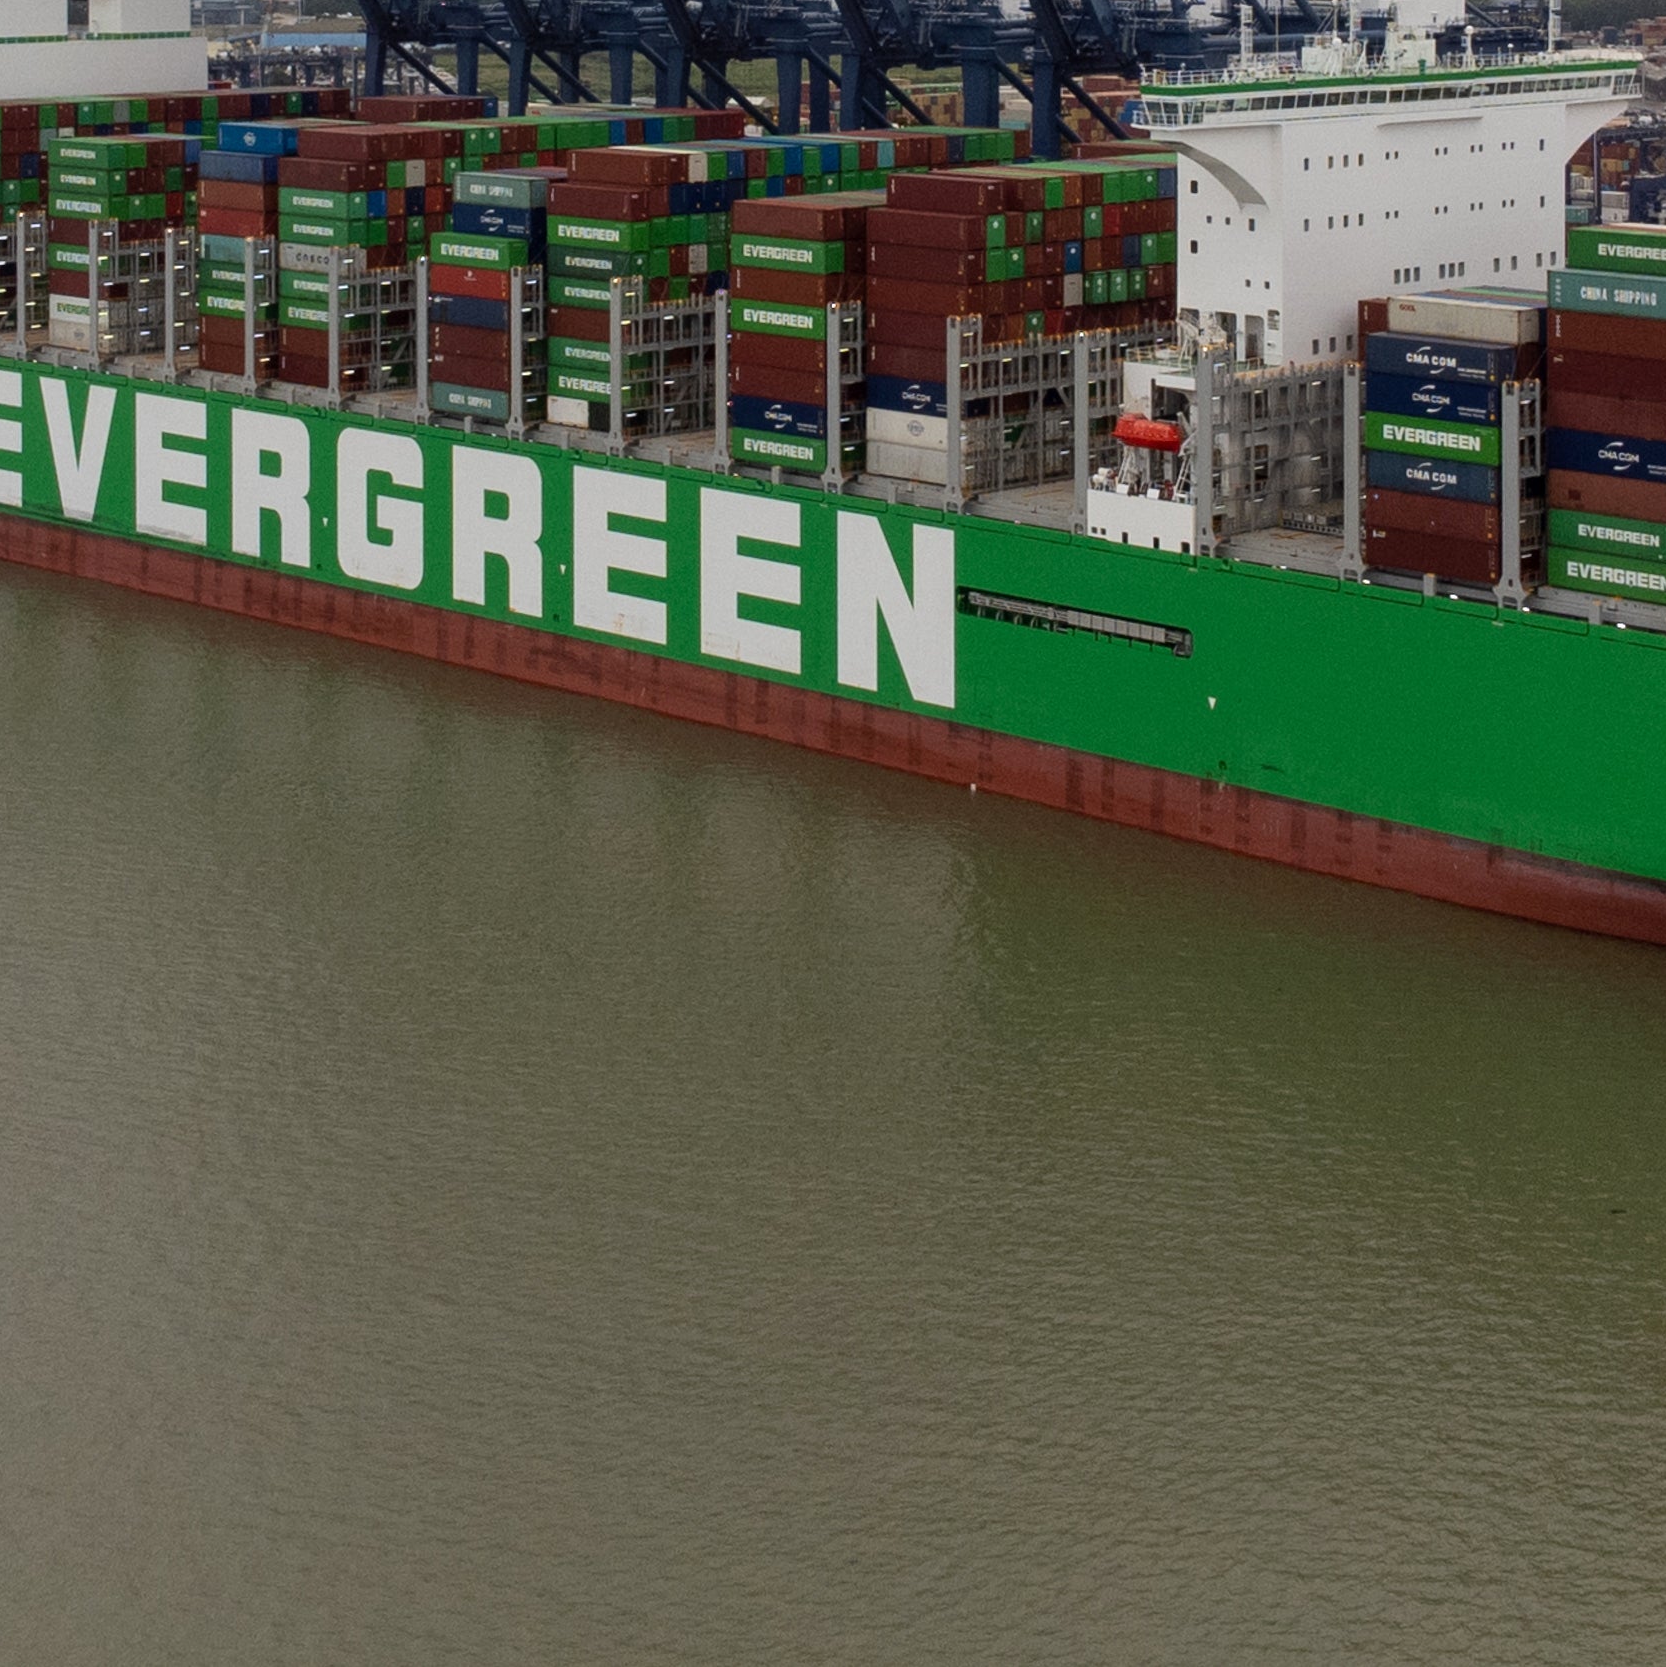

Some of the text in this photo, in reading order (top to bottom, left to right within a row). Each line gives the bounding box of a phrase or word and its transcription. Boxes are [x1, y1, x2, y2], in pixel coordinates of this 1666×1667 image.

[60, 148, 96, 159] EVERGREEN
[56, 199, 101, 214] EVERGREEN
[292, 195, 333, 208] EVERGREEN
[292, 224, 333, 237] EVERGREEN
[558, 224, 620, 242] EVERGREEN
[441, 243, 499, 261] EVERGREEN
[743, 243, 813, 263] EVERGREEN
[565, 256, 612, 270] EVERGREEN
[1580, 285, 1658, 306] CHINA SHIPPING
[743, 308, 813, 329] EVERGREEN
[1405, 351, 1457, 368] CMA CGM
[558, 376, 611, 394] EVERGREE
[1383, 423, 1481, 452] EVERGREEN
[744, 437, 813, 460] EVERGREEN
[1598, 448, 1617, 461] CMA
[1405, 467, 1458, 485] CMA CGM
[1578, 523, 1660, 548] EVERGREEN
